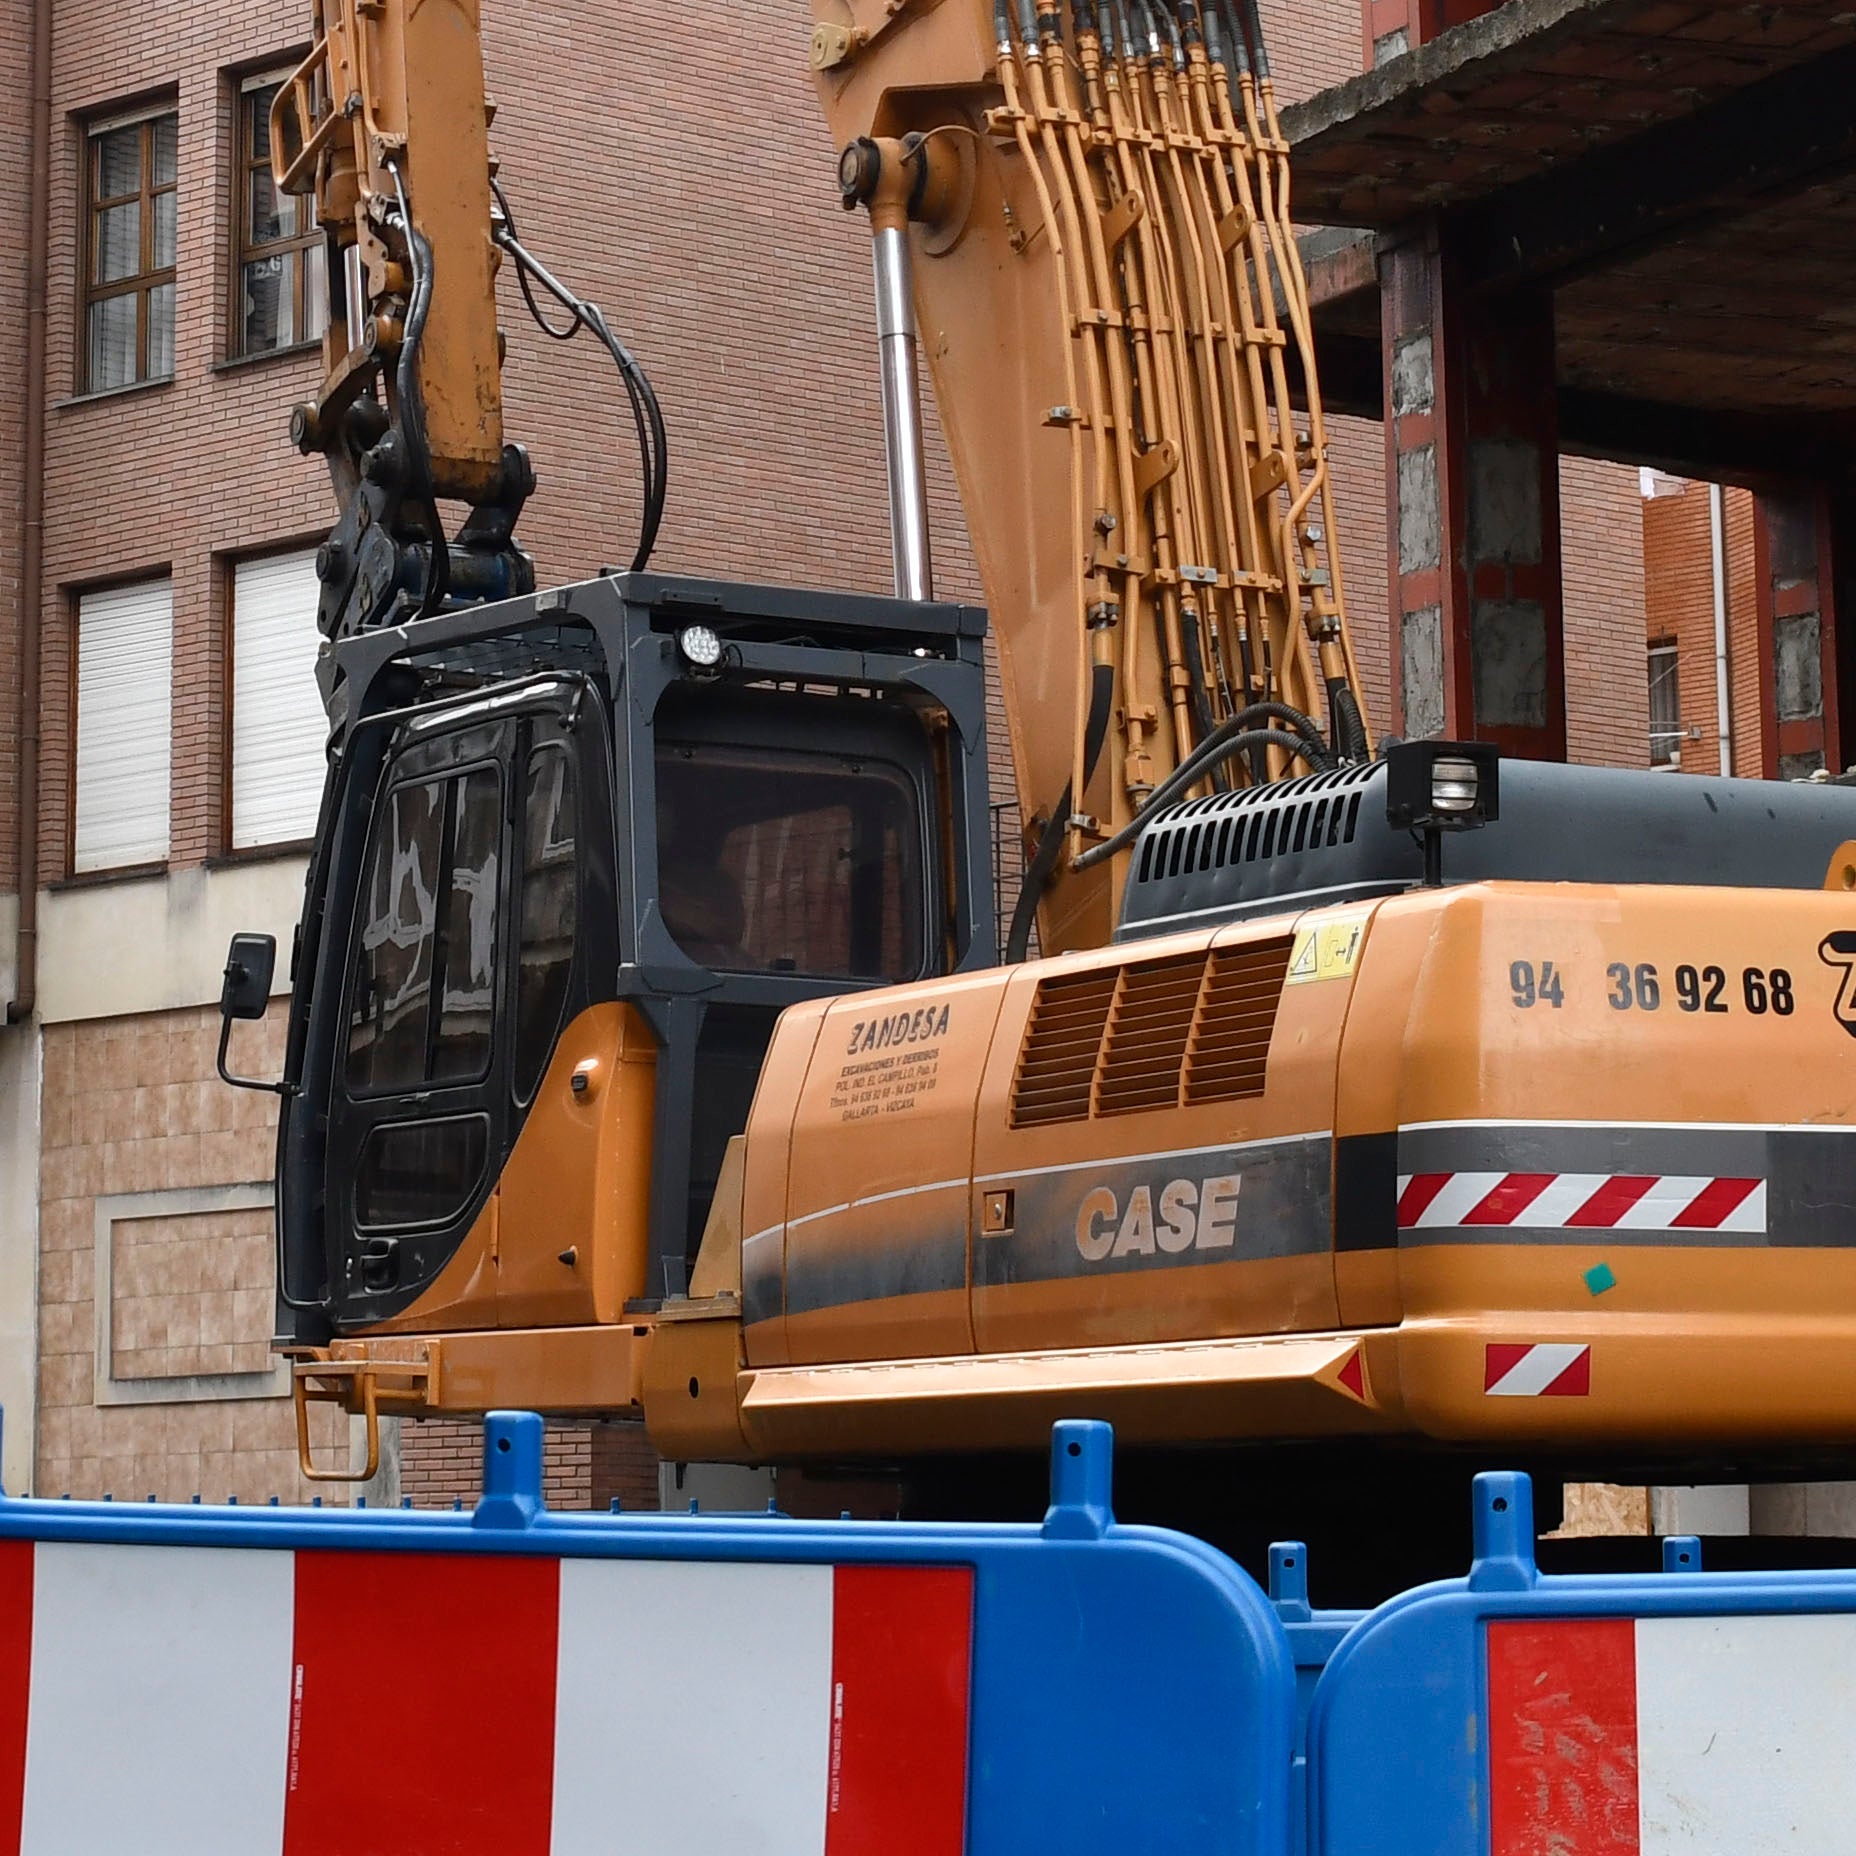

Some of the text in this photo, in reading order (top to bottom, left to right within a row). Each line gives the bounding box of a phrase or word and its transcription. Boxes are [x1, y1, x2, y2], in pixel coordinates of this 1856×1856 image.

[1509, 960, 1795, 1017] 94 36 92 68
[847, 1003, 949, 1055] ZANDESA
[841, 1057, 895, 1077] EXCAVACIONES
[902, 1048, 940, 1064] DERRIBOS
[867, 1074, 876, 1086] EL
[841, 1104, 879, 1121] GALLARTA
[1076, 1174, 1242, 1261] CASE
